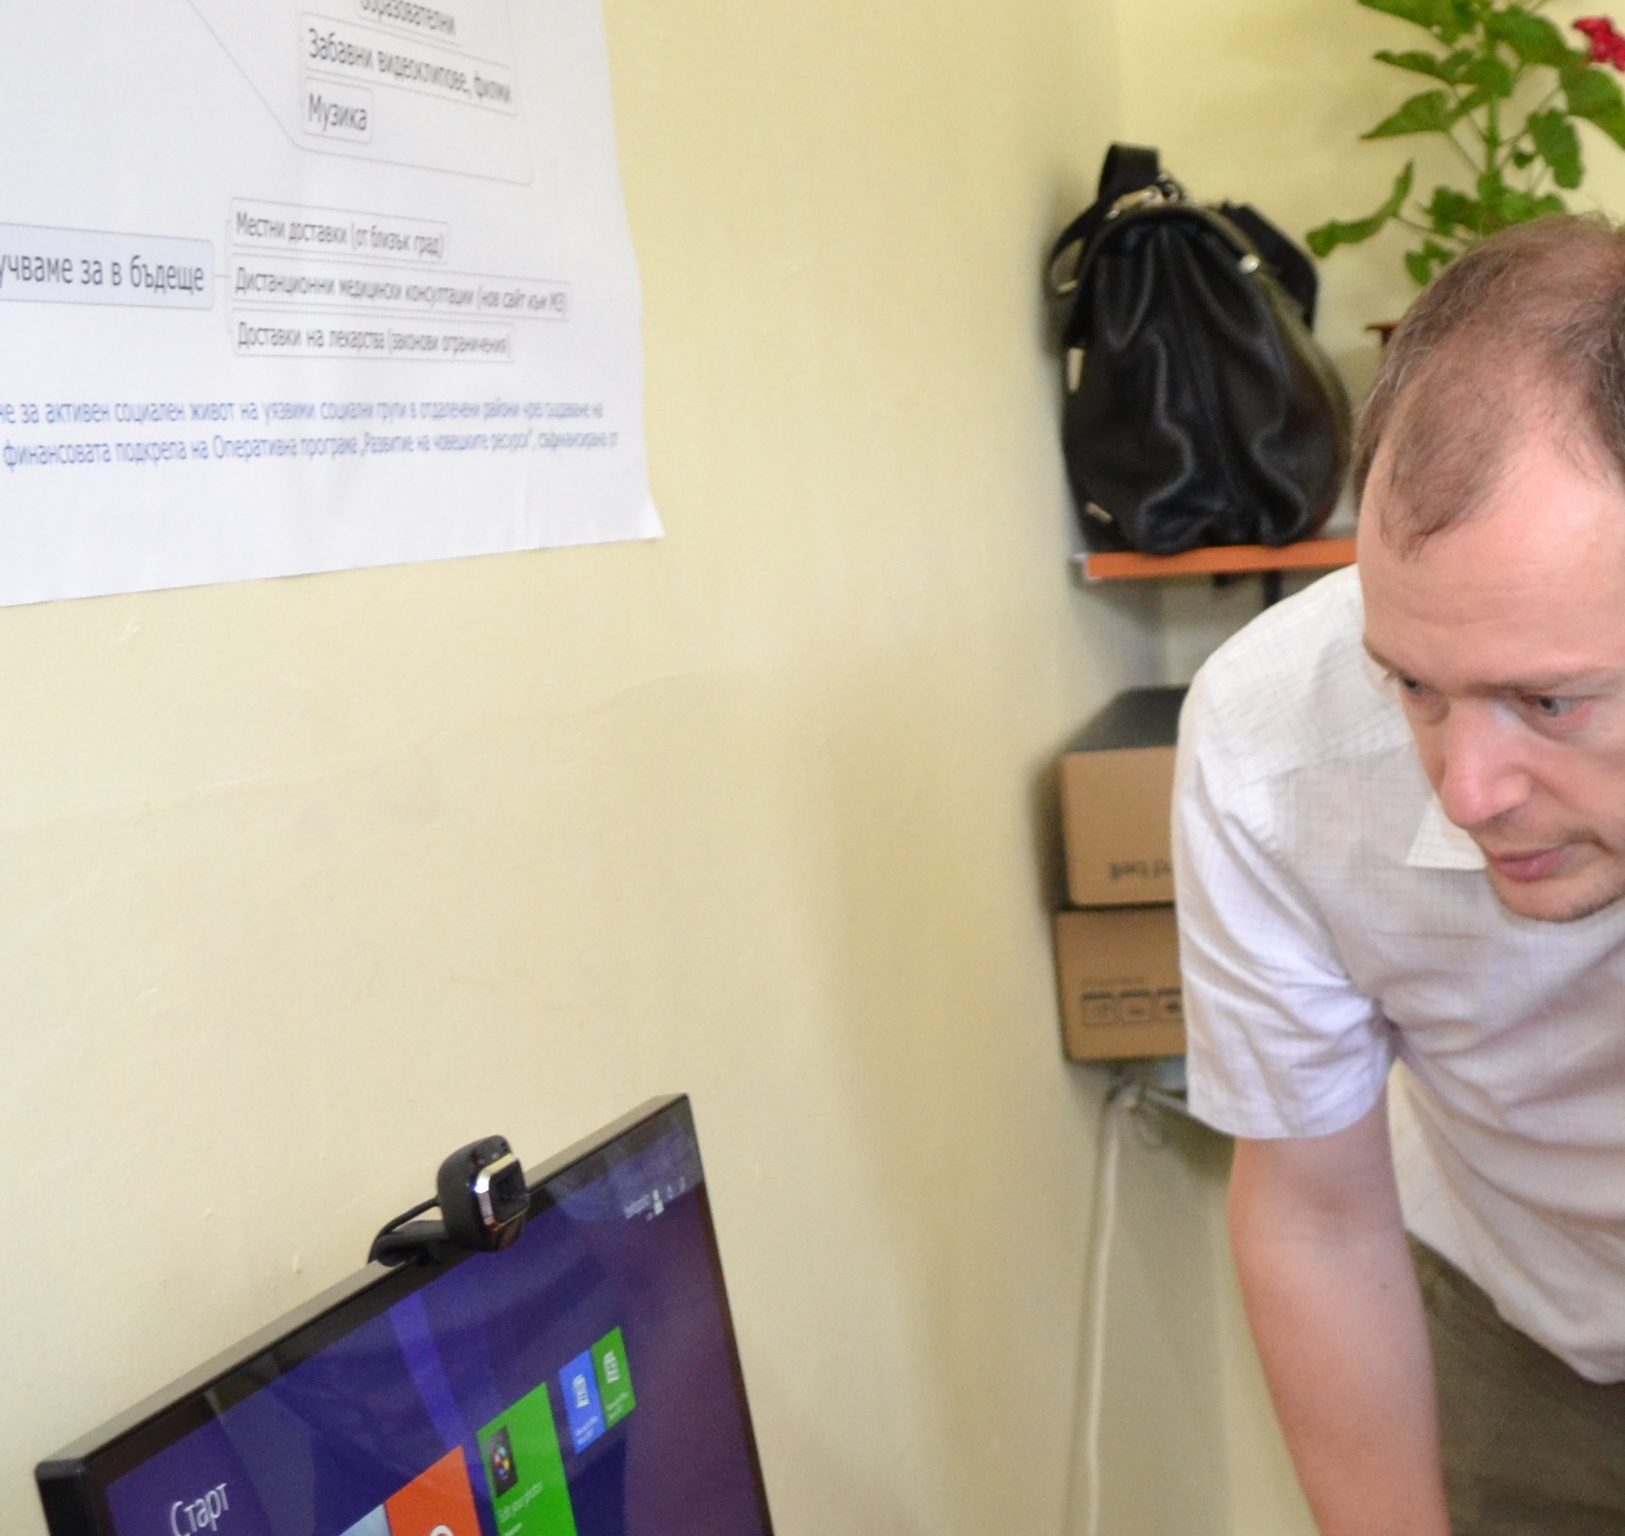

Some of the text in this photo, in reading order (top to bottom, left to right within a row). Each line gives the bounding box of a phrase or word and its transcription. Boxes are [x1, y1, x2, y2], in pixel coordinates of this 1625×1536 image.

[308, 27, 373, 69] Забавни
[377, 50, 472, 99] видеоклипове,
[308, 93, 367, 132] Музика
[236, 211, 444, 260] Местни доставки (от близък град)
[80, 258, 103, 286] за
[111, 261, 123, 286] в
[130, 254, 205, 295] бъдеще
[235, 266, 334, 296] Дистанционни
[339, 279, 402, 301] медицински
[405, 284, 473, 308] консултации
[237, 321, 301, 350] Доставки
[306, 329, 324, 347] на
[329, 330, 384, 353] лекарства
[442, 333, 512, 359] ограничения)
[20, 403, 39, 424] за
[45, 402, 109, 424] активен
[115, 402, 184, 425] социален
[189, 402, 234, 422] живот
[239, 402, 258, 421] на
[263, 402, 315, 425] уязвими
[320, 402, 373, 422] социални
[3, 439, 111, 473] финансовата
[115, 441, 187, 466] подкрепа
[191, 440, 209, 460] на
[213, 434, 298, 463] Оперативна
[300, 437, 357, 460] програма
